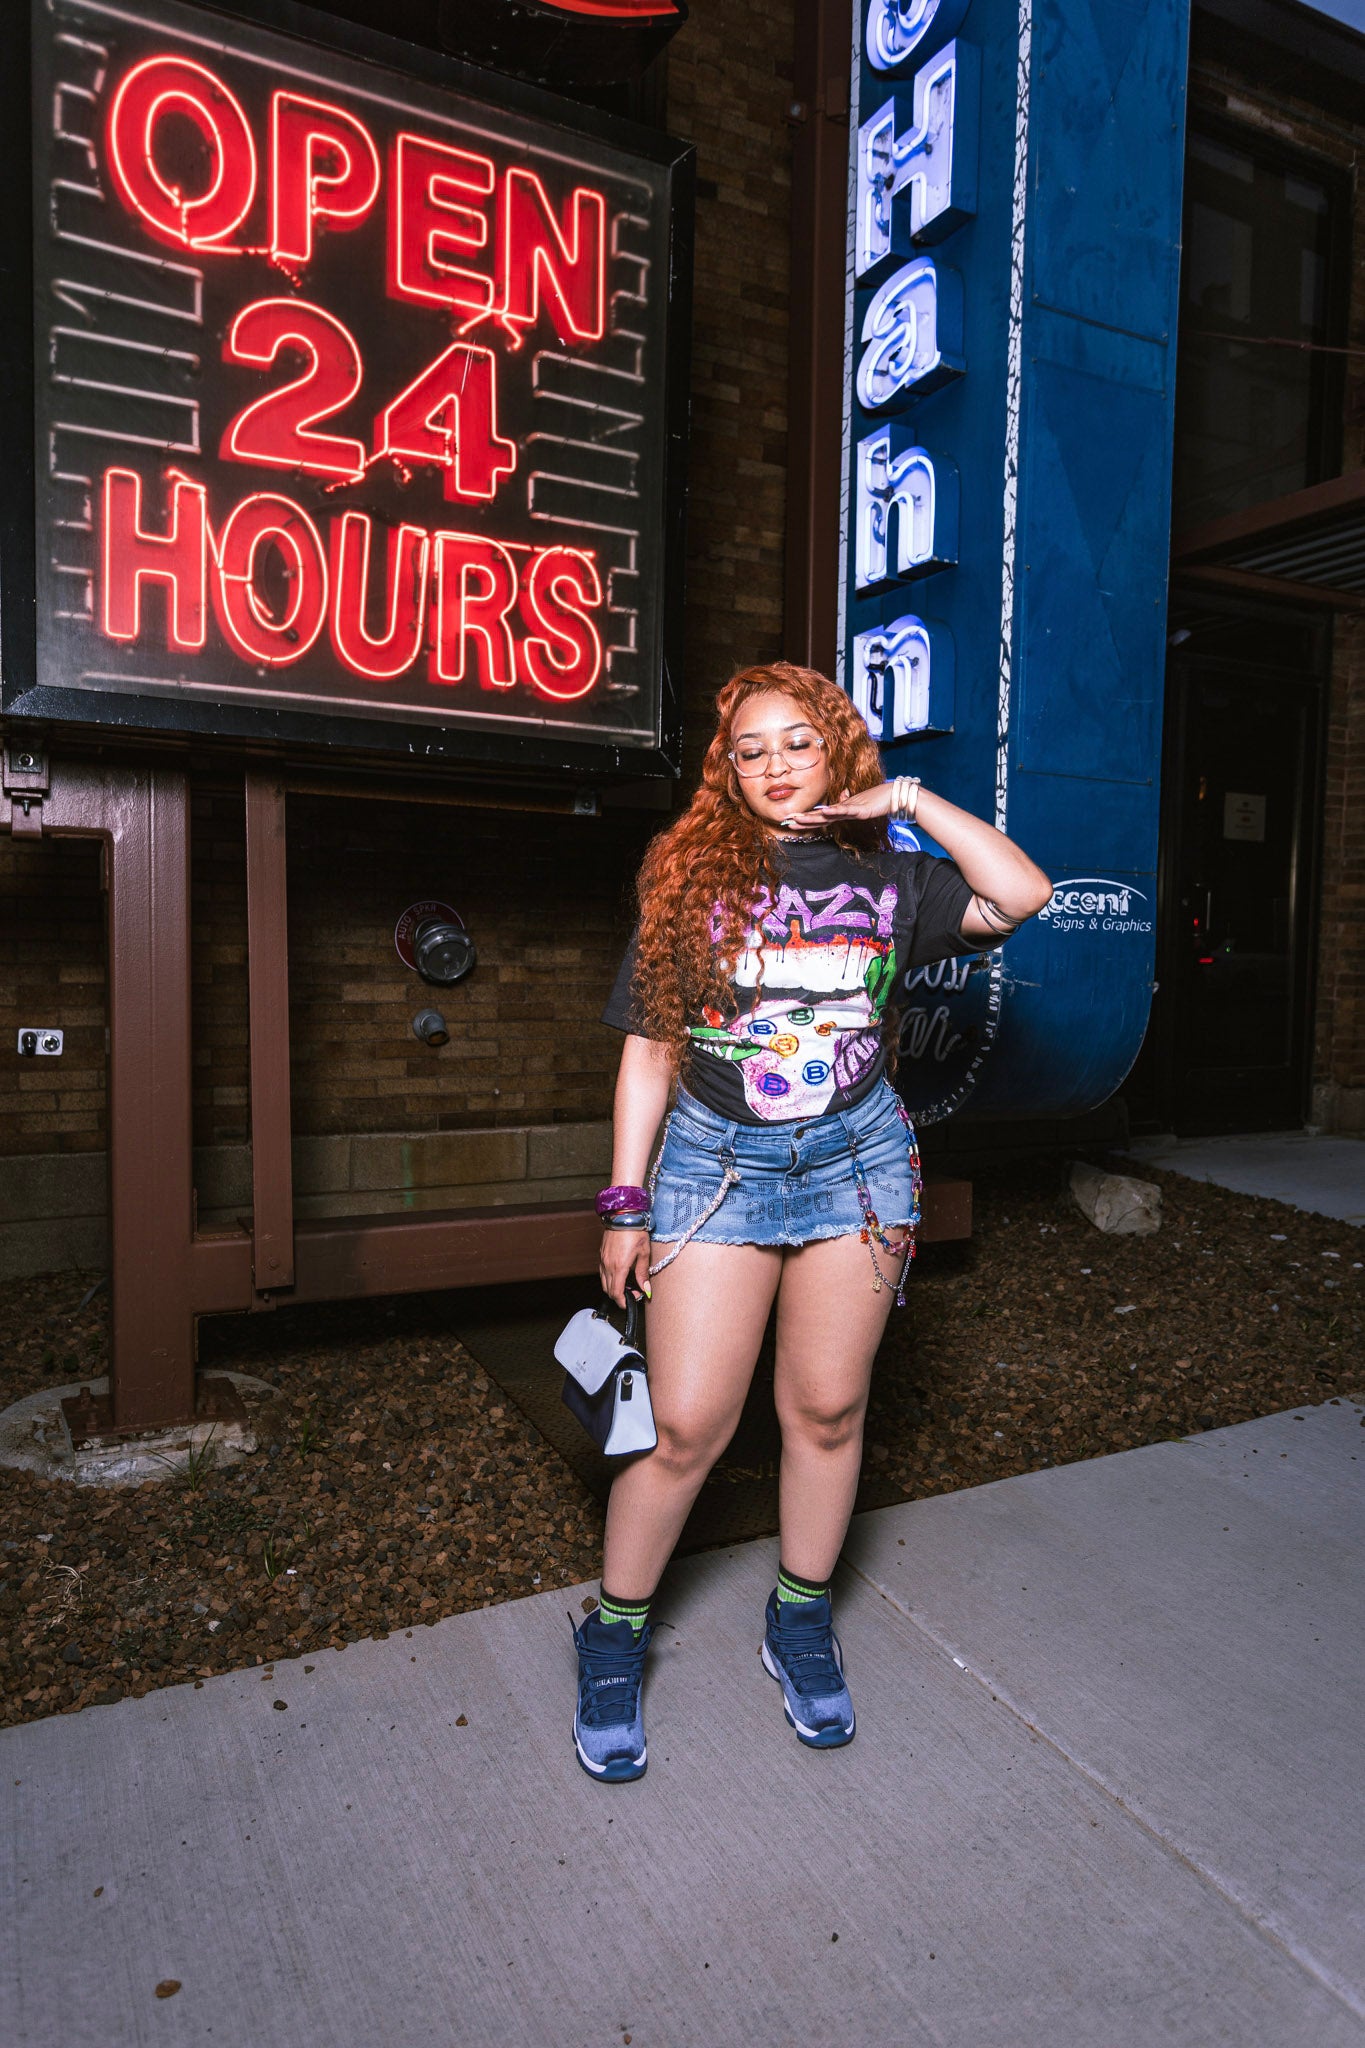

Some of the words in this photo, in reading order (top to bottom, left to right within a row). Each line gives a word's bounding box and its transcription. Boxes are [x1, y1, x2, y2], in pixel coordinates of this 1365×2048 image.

[108, 55, 605, 343] OPEN
[222, 298, 517, 500] 24
[101, 467, 603, 700] HOURS
[399, 915, 411, 939] AUTO
[1052, 915, 1085, 932] Signs
[1089, 917, 1098, 930] &
[1102, 918, 1152, 934] Graphics
